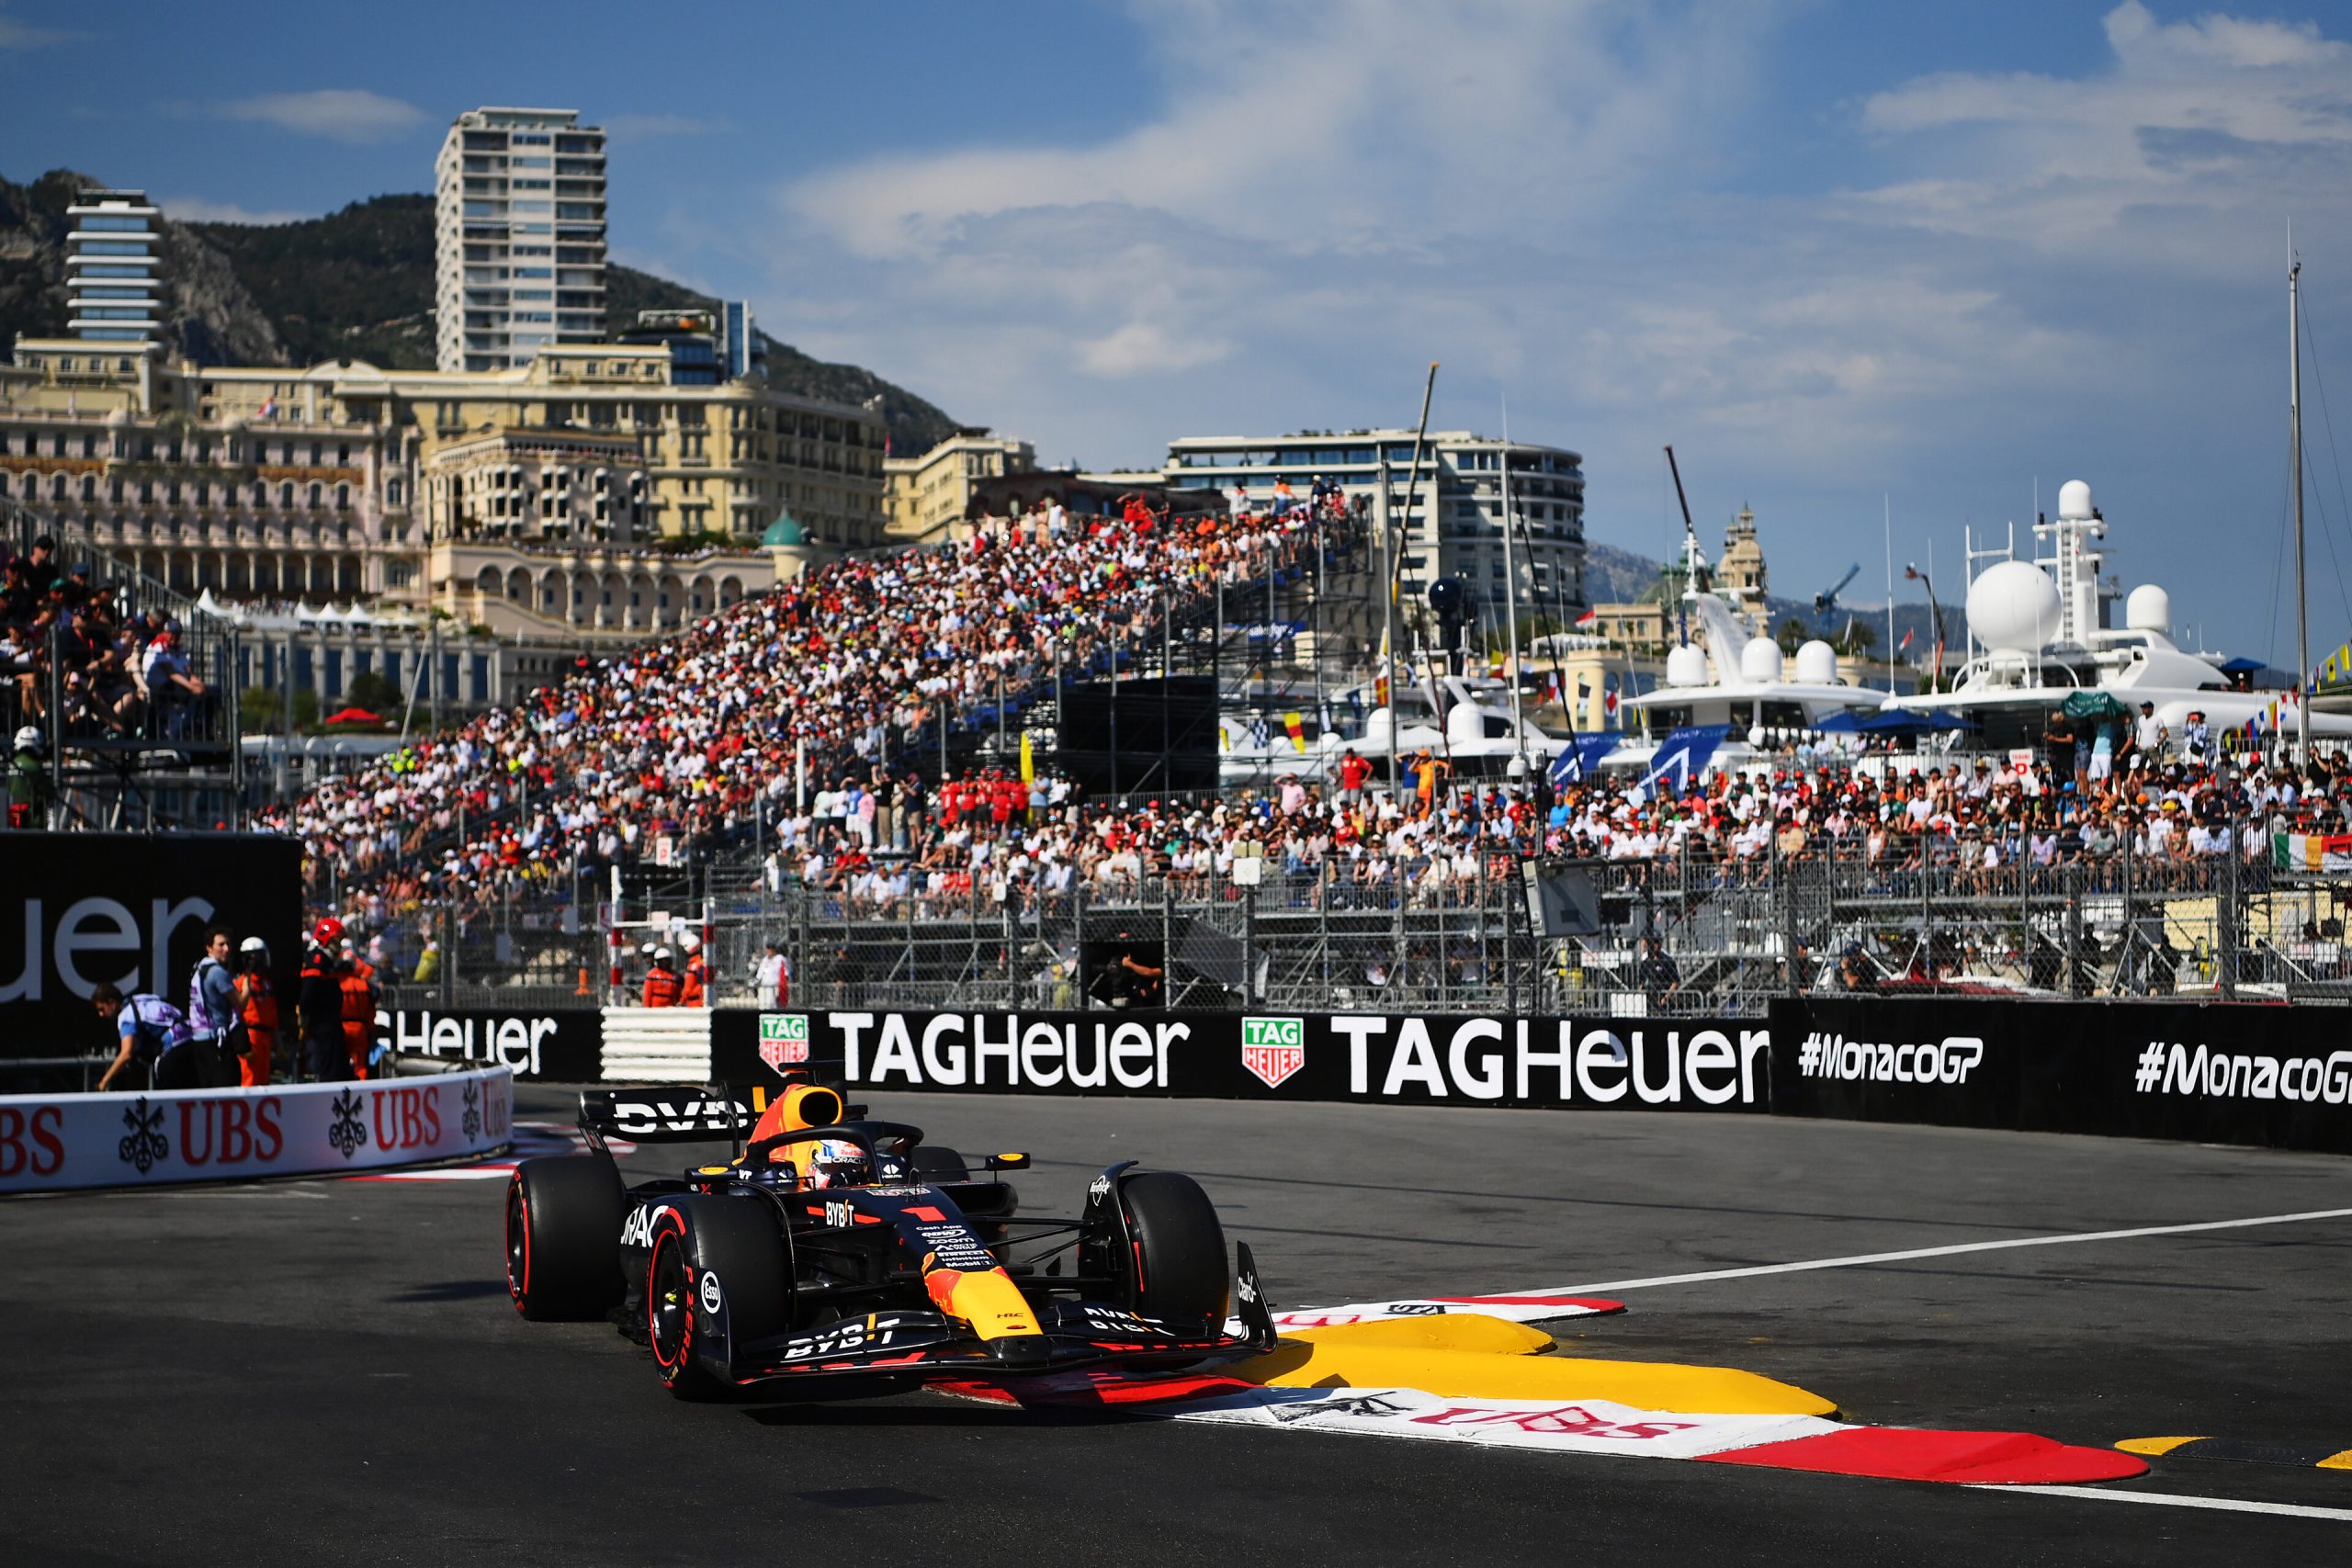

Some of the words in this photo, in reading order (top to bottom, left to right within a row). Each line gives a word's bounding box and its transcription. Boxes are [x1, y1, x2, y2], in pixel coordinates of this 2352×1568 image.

[763, 1019, 804, 1038] TAG
[1247, 1021, 1298, 1044] TAG
[763, 1043, 806, 1068] HEUER
[1246, 1048, 1301, 1082] HEUER
[1798, 1032, 1984, 1085] #MonacoGP
[2135, 1042, 2352, 1104] #MonacoG
[175, 1096, 284, 1167] UBS
[371, 1086, 441, 1152] UBS
[0, 1105, 65, 1177] BS
[826, 1199, 854, 1228] BYBIT
[704, 1281, 719, 1302] Esso
[1410, 1406, 1701, 1439] UBS
